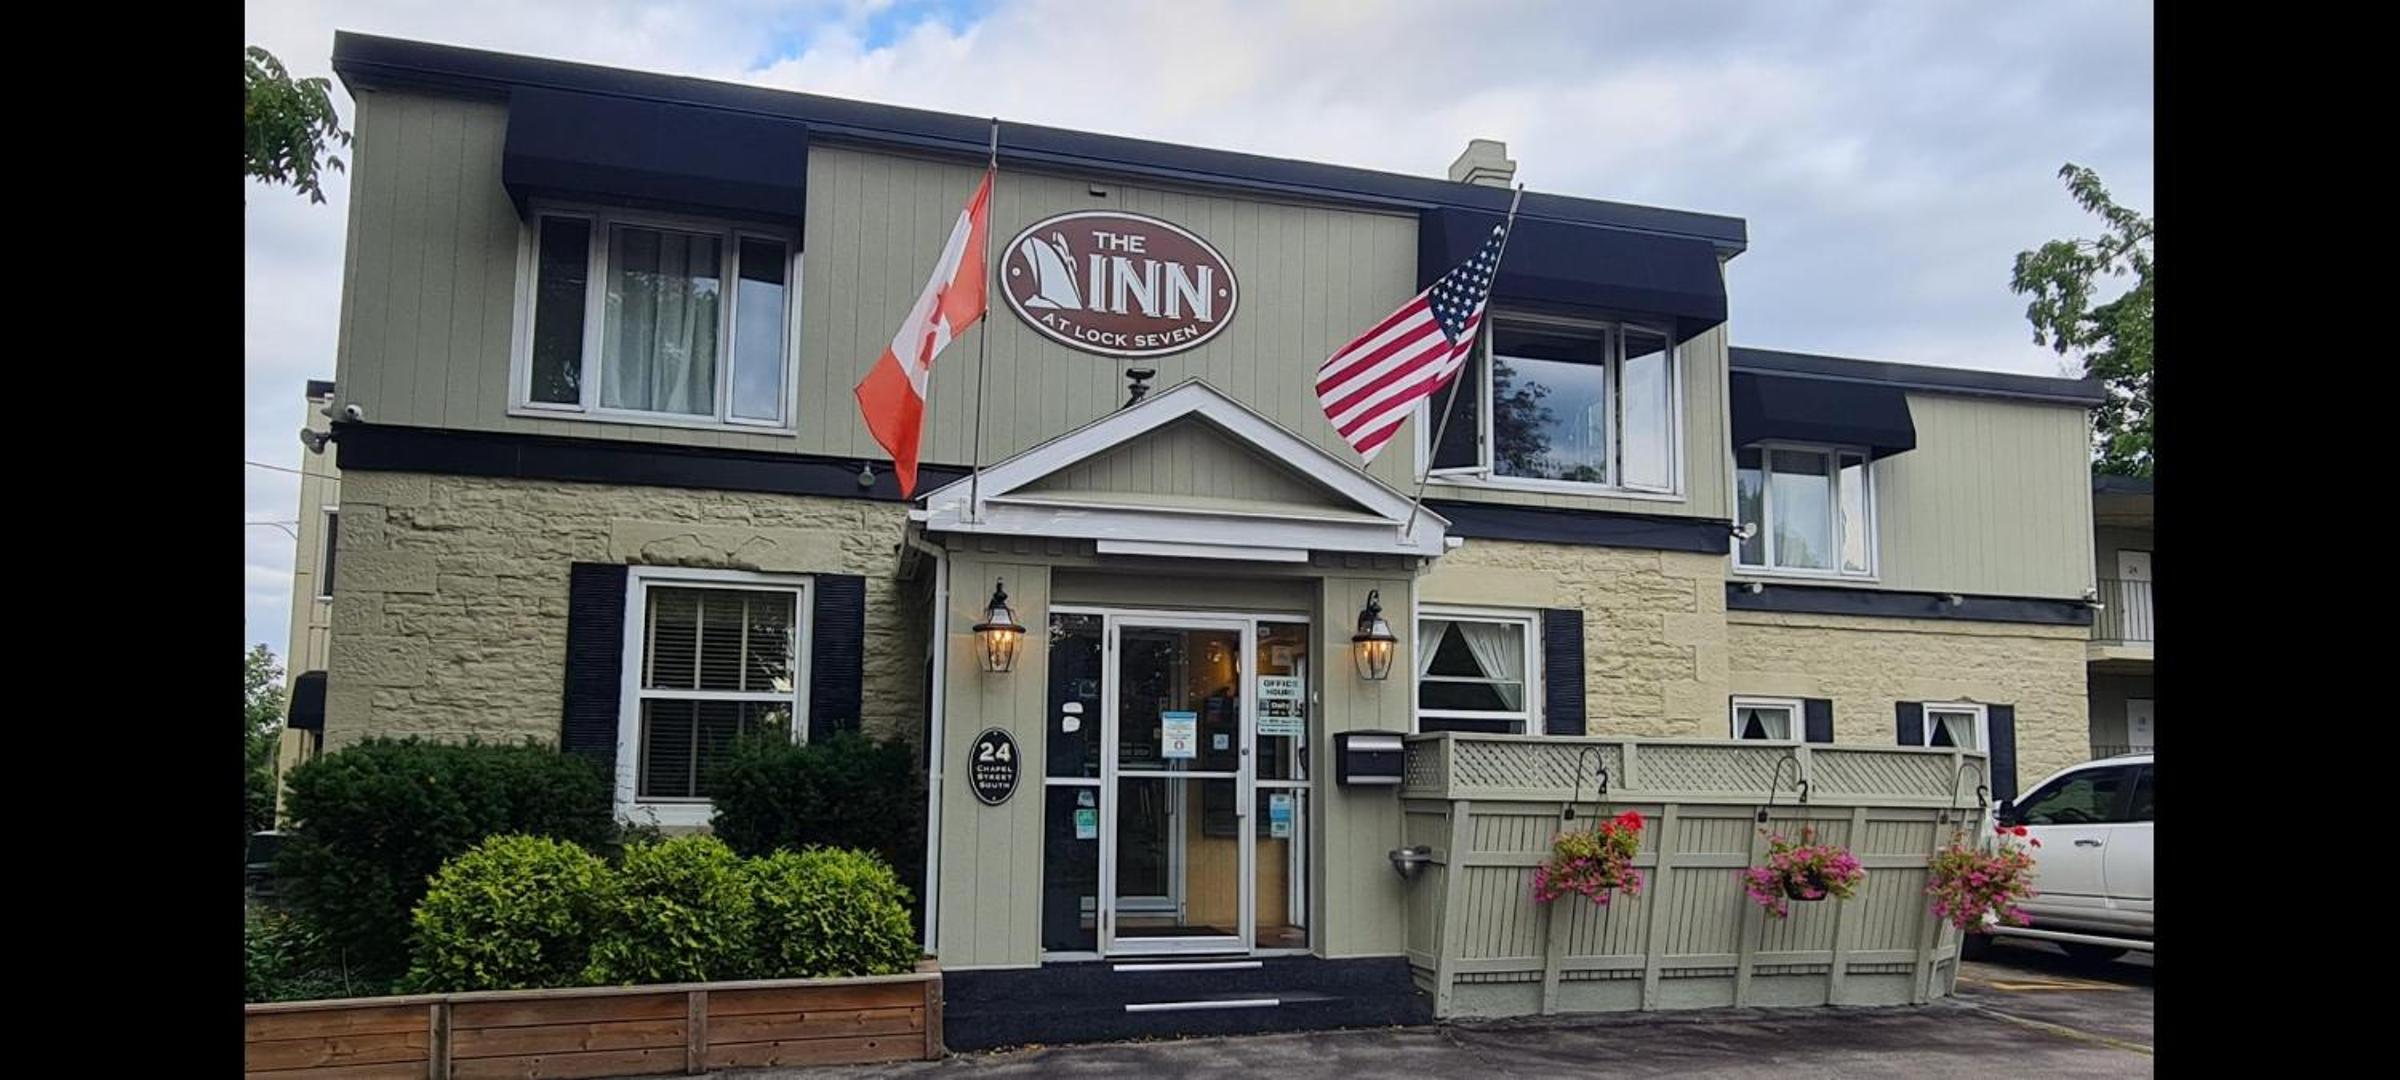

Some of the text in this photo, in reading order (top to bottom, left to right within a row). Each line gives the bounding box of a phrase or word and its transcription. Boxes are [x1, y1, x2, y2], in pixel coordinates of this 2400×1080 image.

[1092, 231, 1145, 253] THE
[1088, 253, 1214, 323] INN
[1042, 313, 1199, 347] AT LOCK SEVEN
[979, 742, 1010, 762] 24
